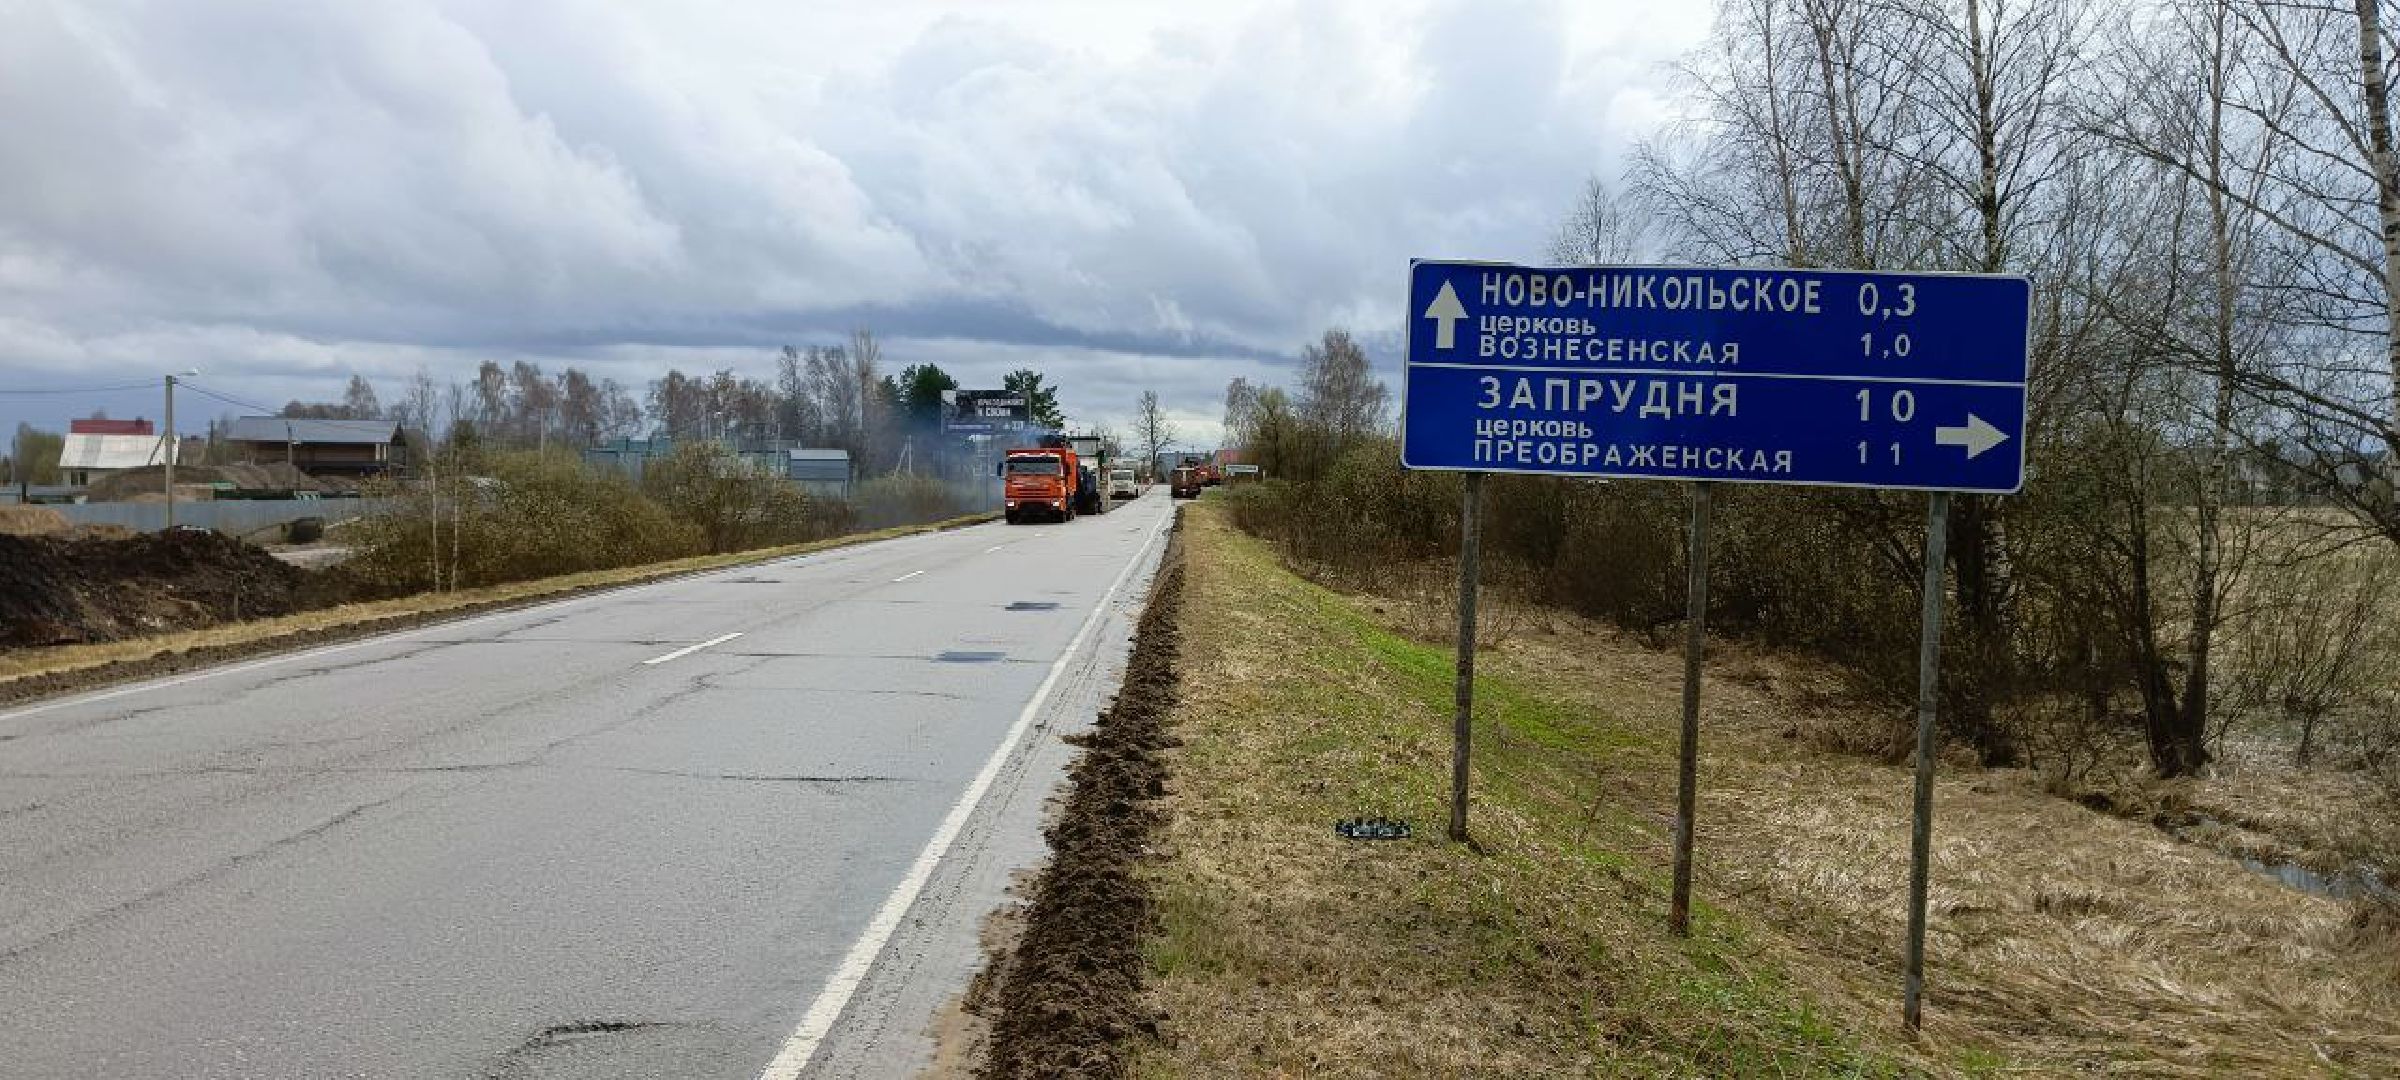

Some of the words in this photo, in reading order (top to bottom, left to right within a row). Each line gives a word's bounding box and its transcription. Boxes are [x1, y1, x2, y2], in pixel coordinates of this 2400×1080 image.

[1481, 272, 1822, 313] НОВО-НИКОЛЬСКОЕ
[1858, 281, 1916, 321] 0,3
[1479, 315, 1597, 336] церковь
[1479, 336, 1740, 364] ВОЗНЕСЕНСКАЯ
[1860, 332, 1911, 359] 1,0
[1476, 375, 1738, 420] ЗАПРУДНЯ
[1475, 418, 1594, 441] церковь
[1473, 439, 1793, 473] ПРЕОБРАЖЕНСКАЯ
